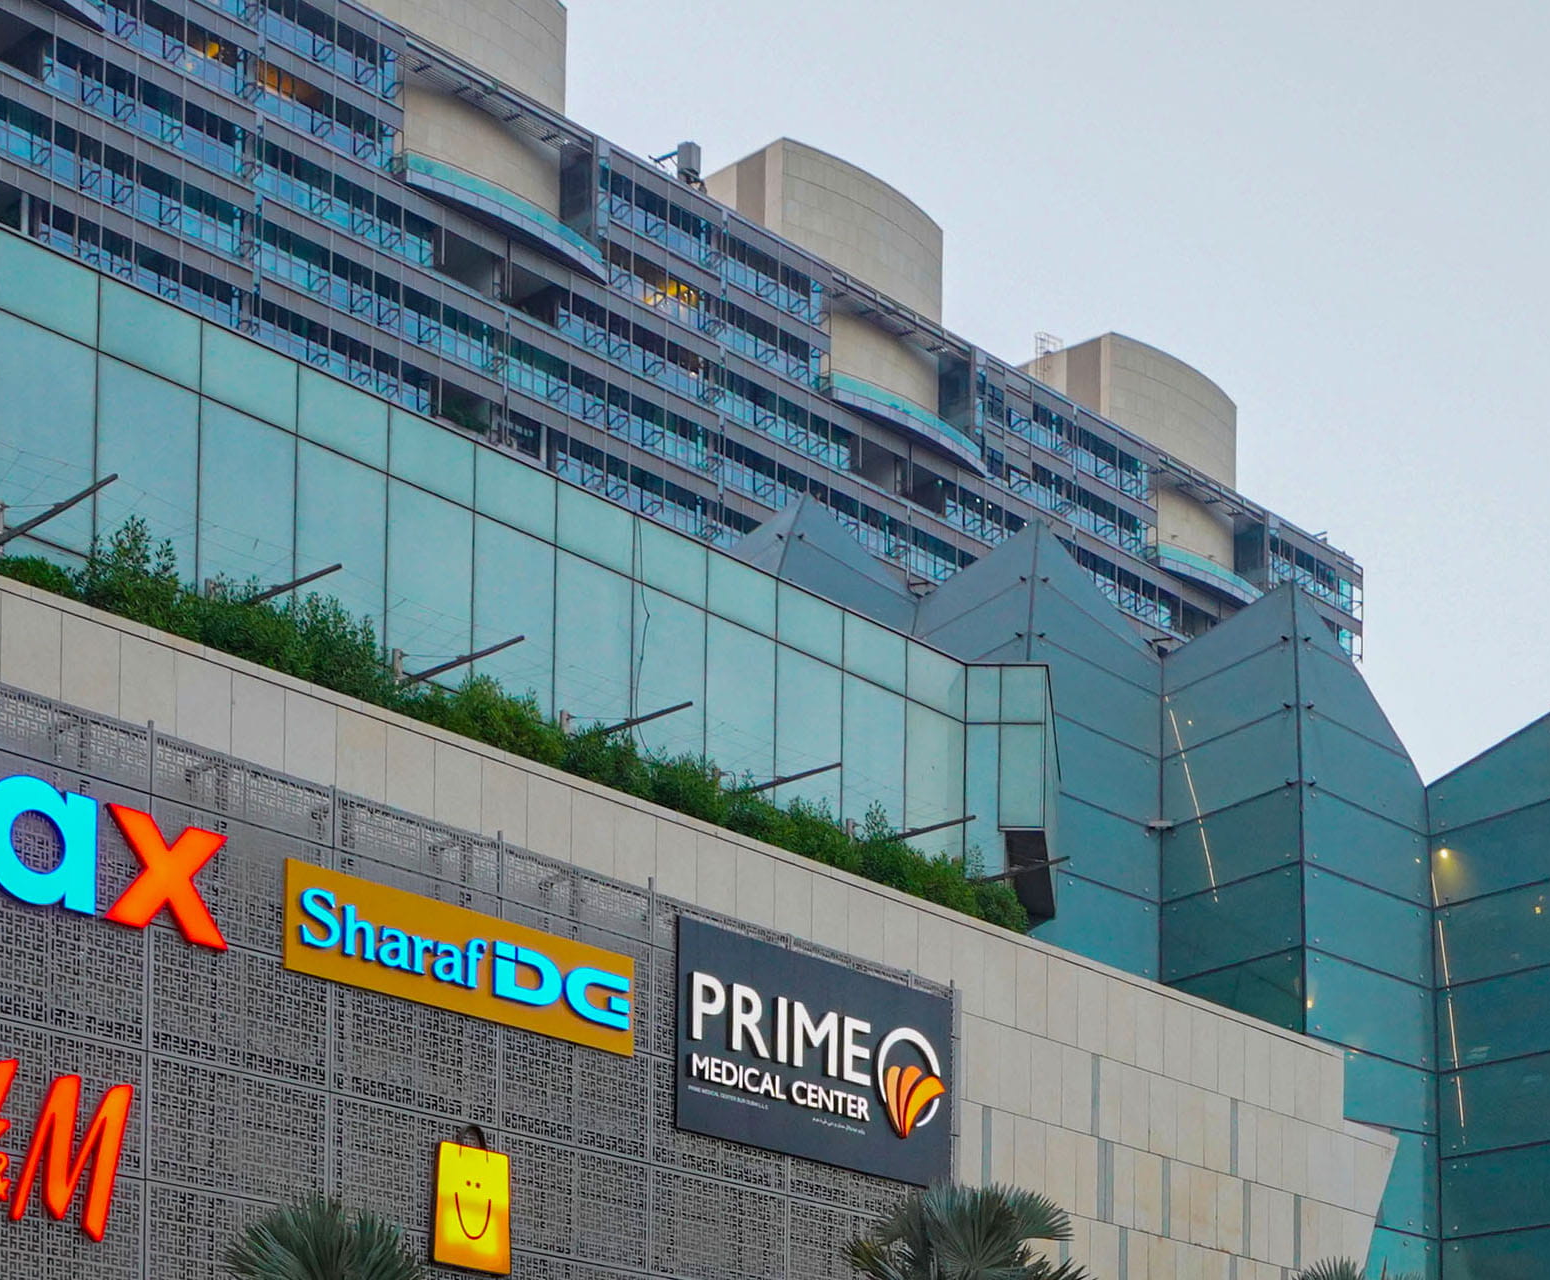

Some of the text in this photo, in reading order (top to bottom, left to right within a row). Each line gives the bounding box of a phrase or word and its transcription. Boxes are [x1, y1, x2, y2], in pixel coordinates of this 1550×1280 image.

[299, 887, 631, 1032] Sharaf DG
[689, 969, 872, 1086] PRIME
[691, 1052, 871, 1122] MEDICAL CENTER
